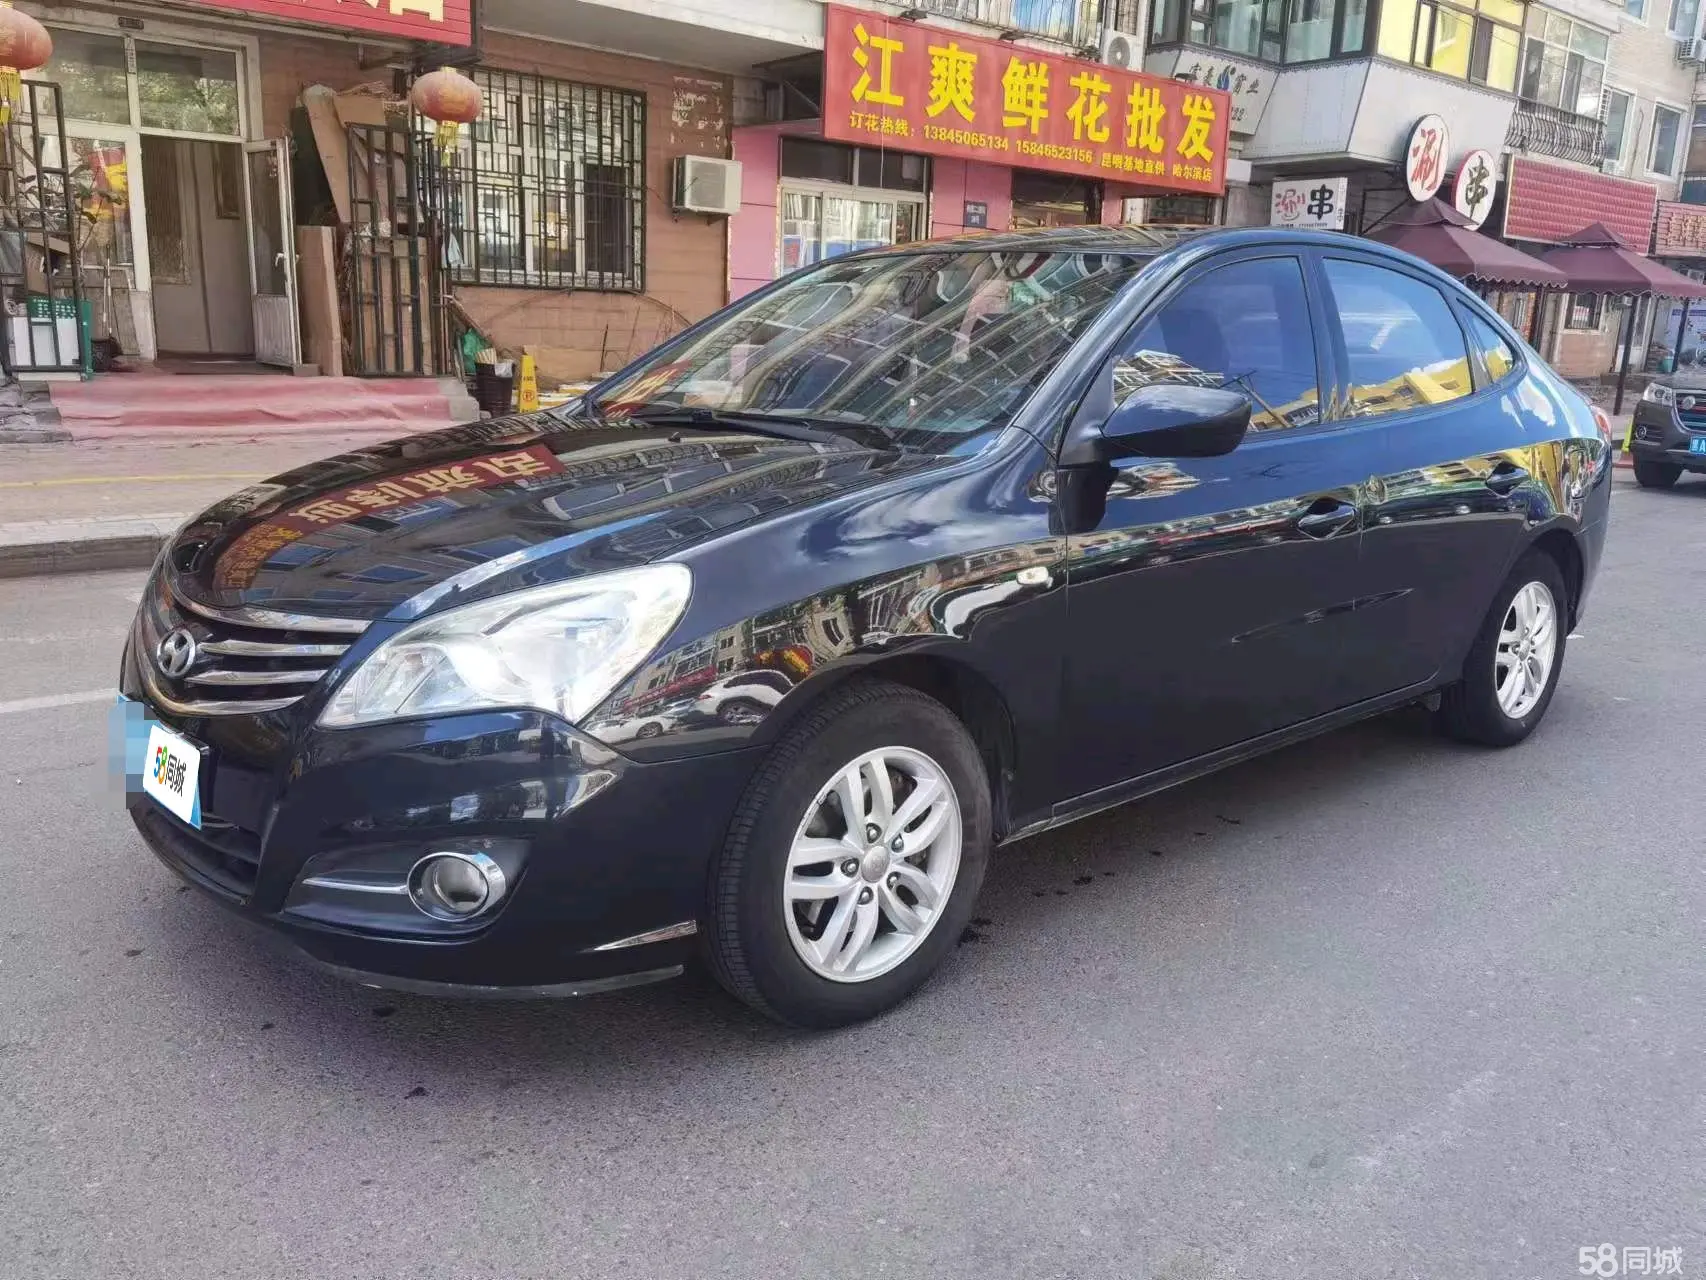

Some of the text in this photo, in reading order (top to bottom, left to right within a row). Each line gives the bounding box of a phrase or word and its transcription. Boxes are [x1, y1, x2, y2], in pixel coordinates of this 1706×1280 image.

[851, 22, 1217, 162] 江爽鲜花批发
[923, 124, 1009, 151] 13845065134
[1016, 139, 1094, 164] 15846523156
[1172, 163, 1213, 183] 哈尔滨店
